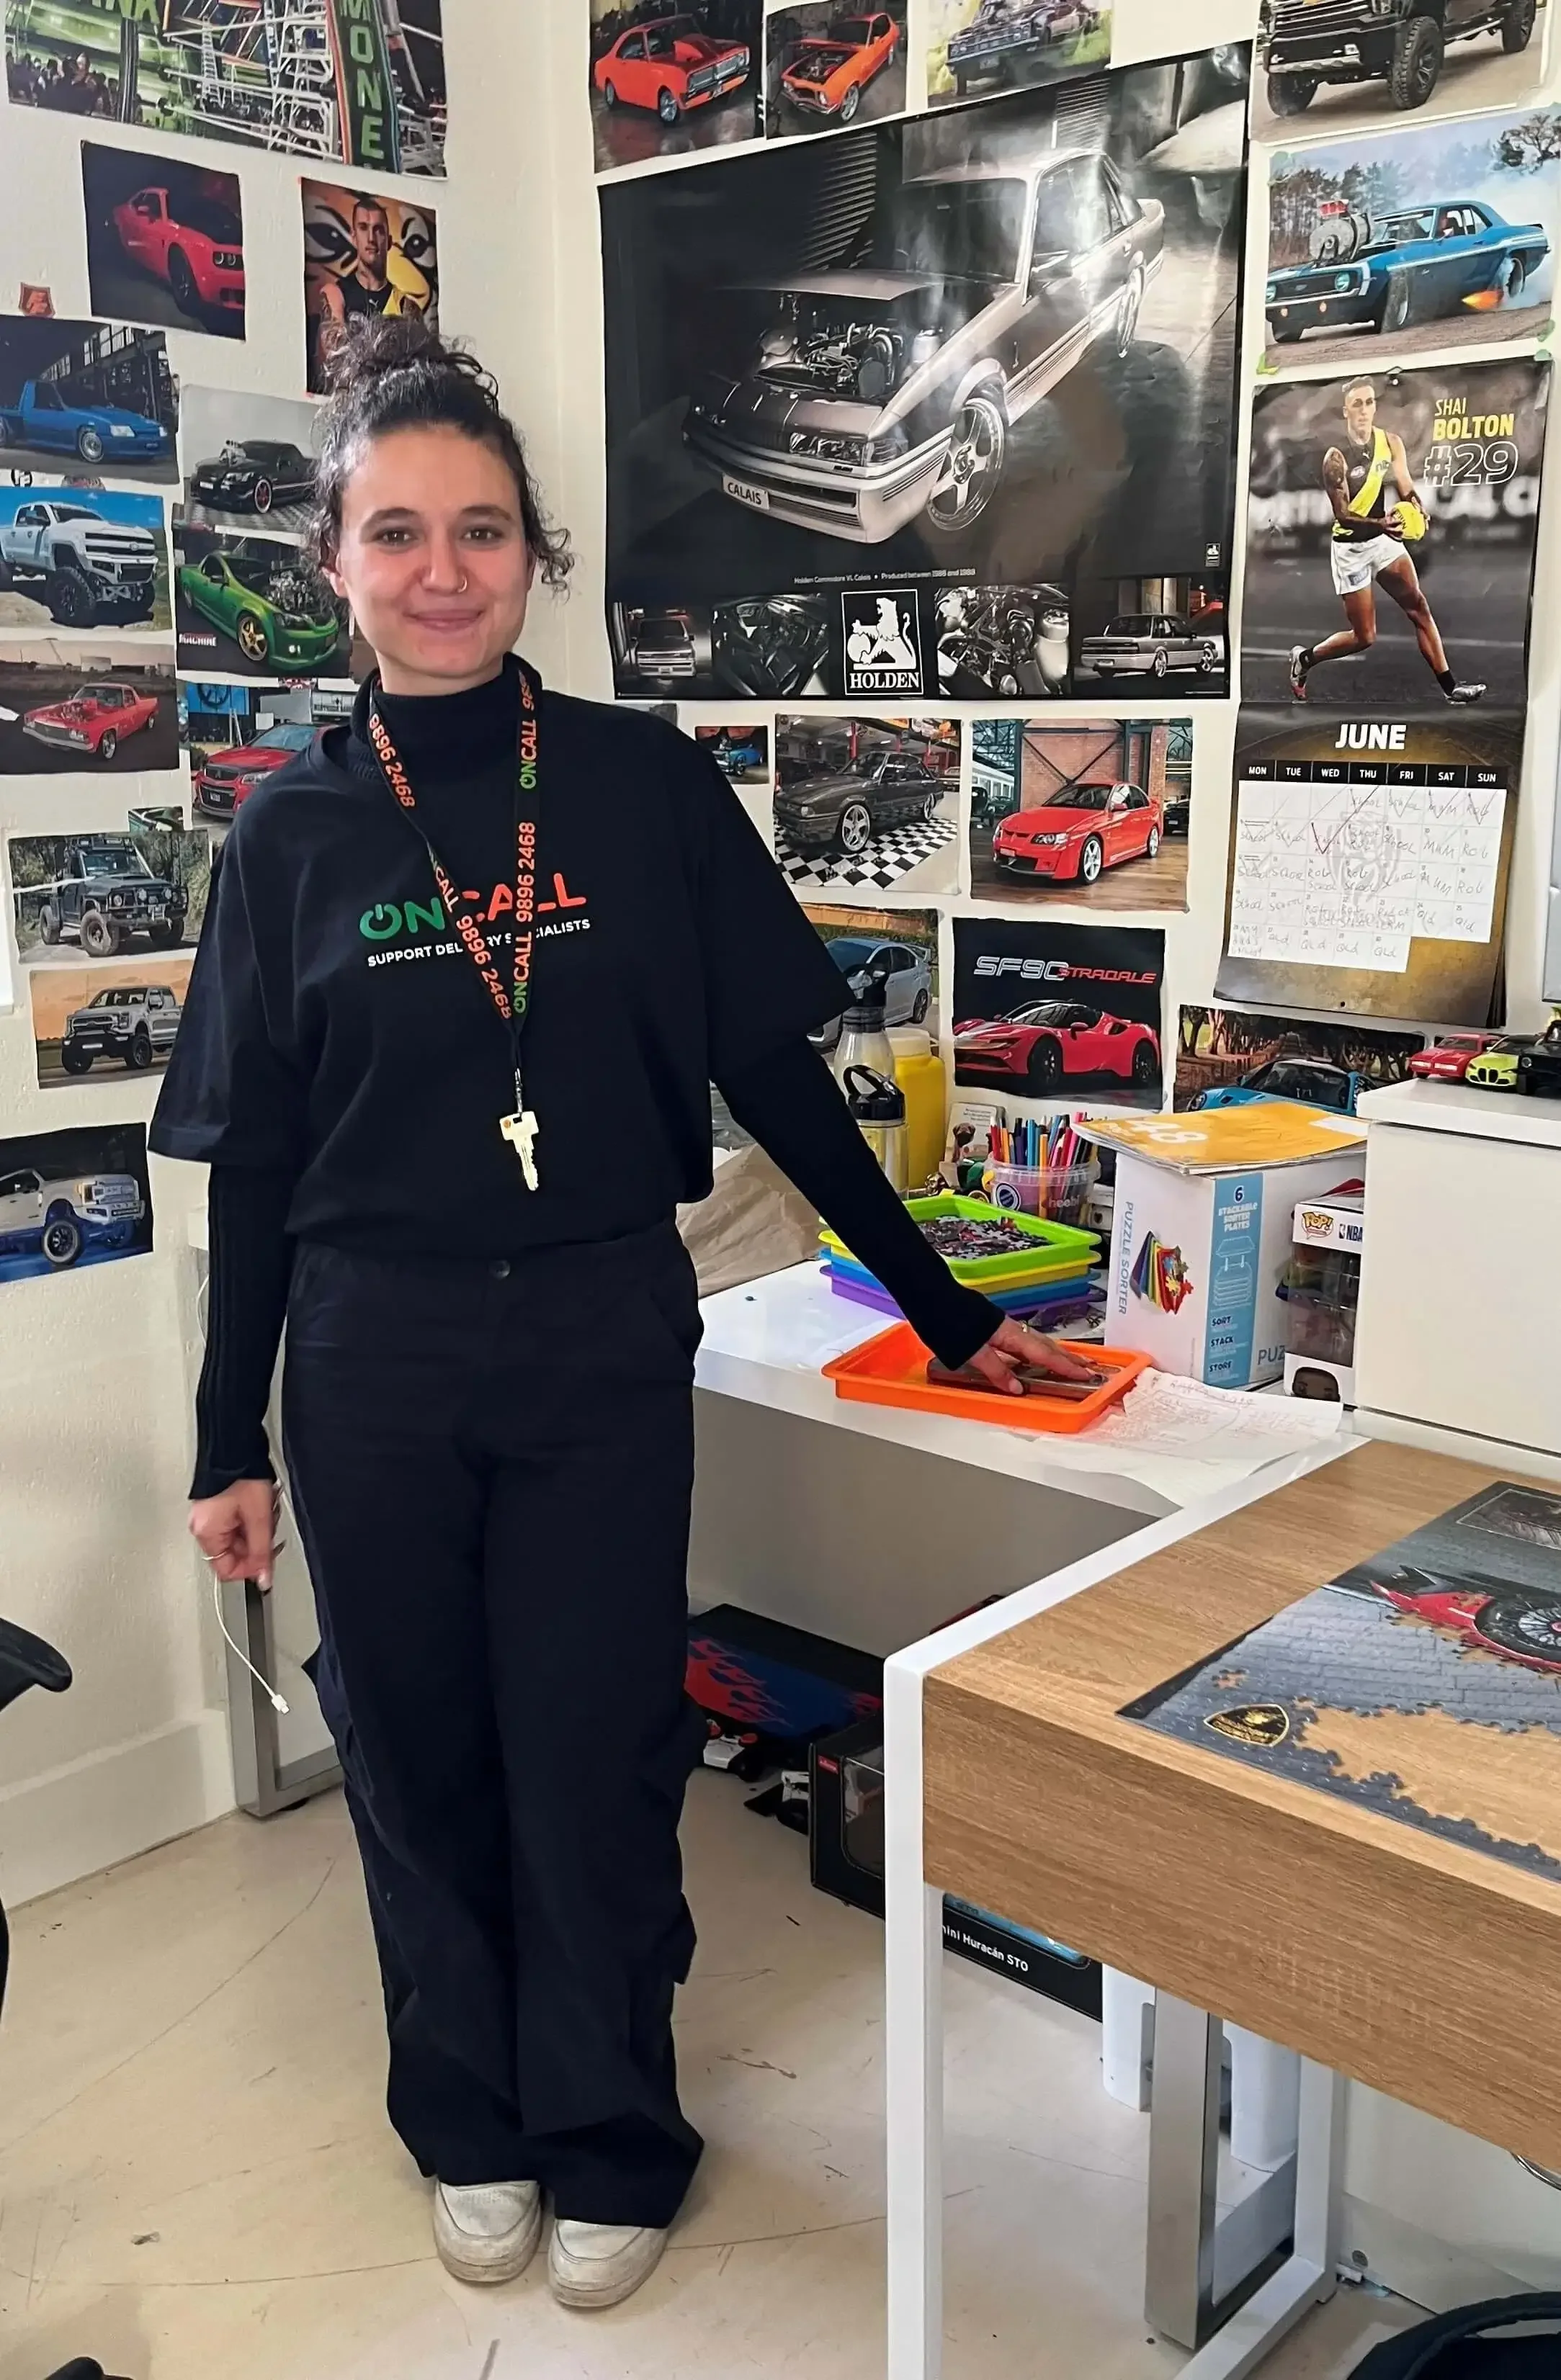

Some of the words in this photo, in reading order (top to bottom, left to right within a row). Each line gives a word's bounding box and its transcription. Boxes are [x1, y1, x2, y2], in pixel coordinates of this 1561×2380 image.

[1434, 397, 1467, 417] SHAI
[1432, 413, 1515, 441] BOLTON
[1423, 441, 1519, 488] #29
[727, 482, 762, 506] CALAIS
[849, 672, 920, 689] HOLDEN
[1335, 724, 1407, 750] JUNE
[369, 713, 397, 762] 9896
[385, 761, 416, 808] 2468
[519, 719, 537, 790] ONCALL
[1248, 766, 1267, 775] MON
[1286, 767, 1302, 776] TUE
[1321, 768, 1340, 778] WED
[1359, 769, 1377, 778] THU
[1399, 771, 1414, 780] FRI
[1438, 772, 1455, 781] SAT
[1477, 773, 1496, 783] SUN
[518, 822, 536, 871] 2468
[516, 874, 535, 922] 9896
[367, 946, 432, 967] SUPPORT
[455, 915, 492, 965] 9896
[480, 968, 512, 1020] 2468
[513, 931, 532, 1014] ONCALL
[1057, 966, 1158, 984] STRADALE
[1233, 1185, 1245, 1203] 6
[1122, 1201, 1134, 1256] PUZZLE
[1302, 1212, 1334, 1230] POP!
[1118, 1257, 1130, 1315] SORTER
[1212, 1316, 1232, 1326] SORT
[1210, 1336, 1234, 1347] STACK
[962, 1933, 1005, 1961] Huracán
[1006, 1954, 1029, 1972] STO
